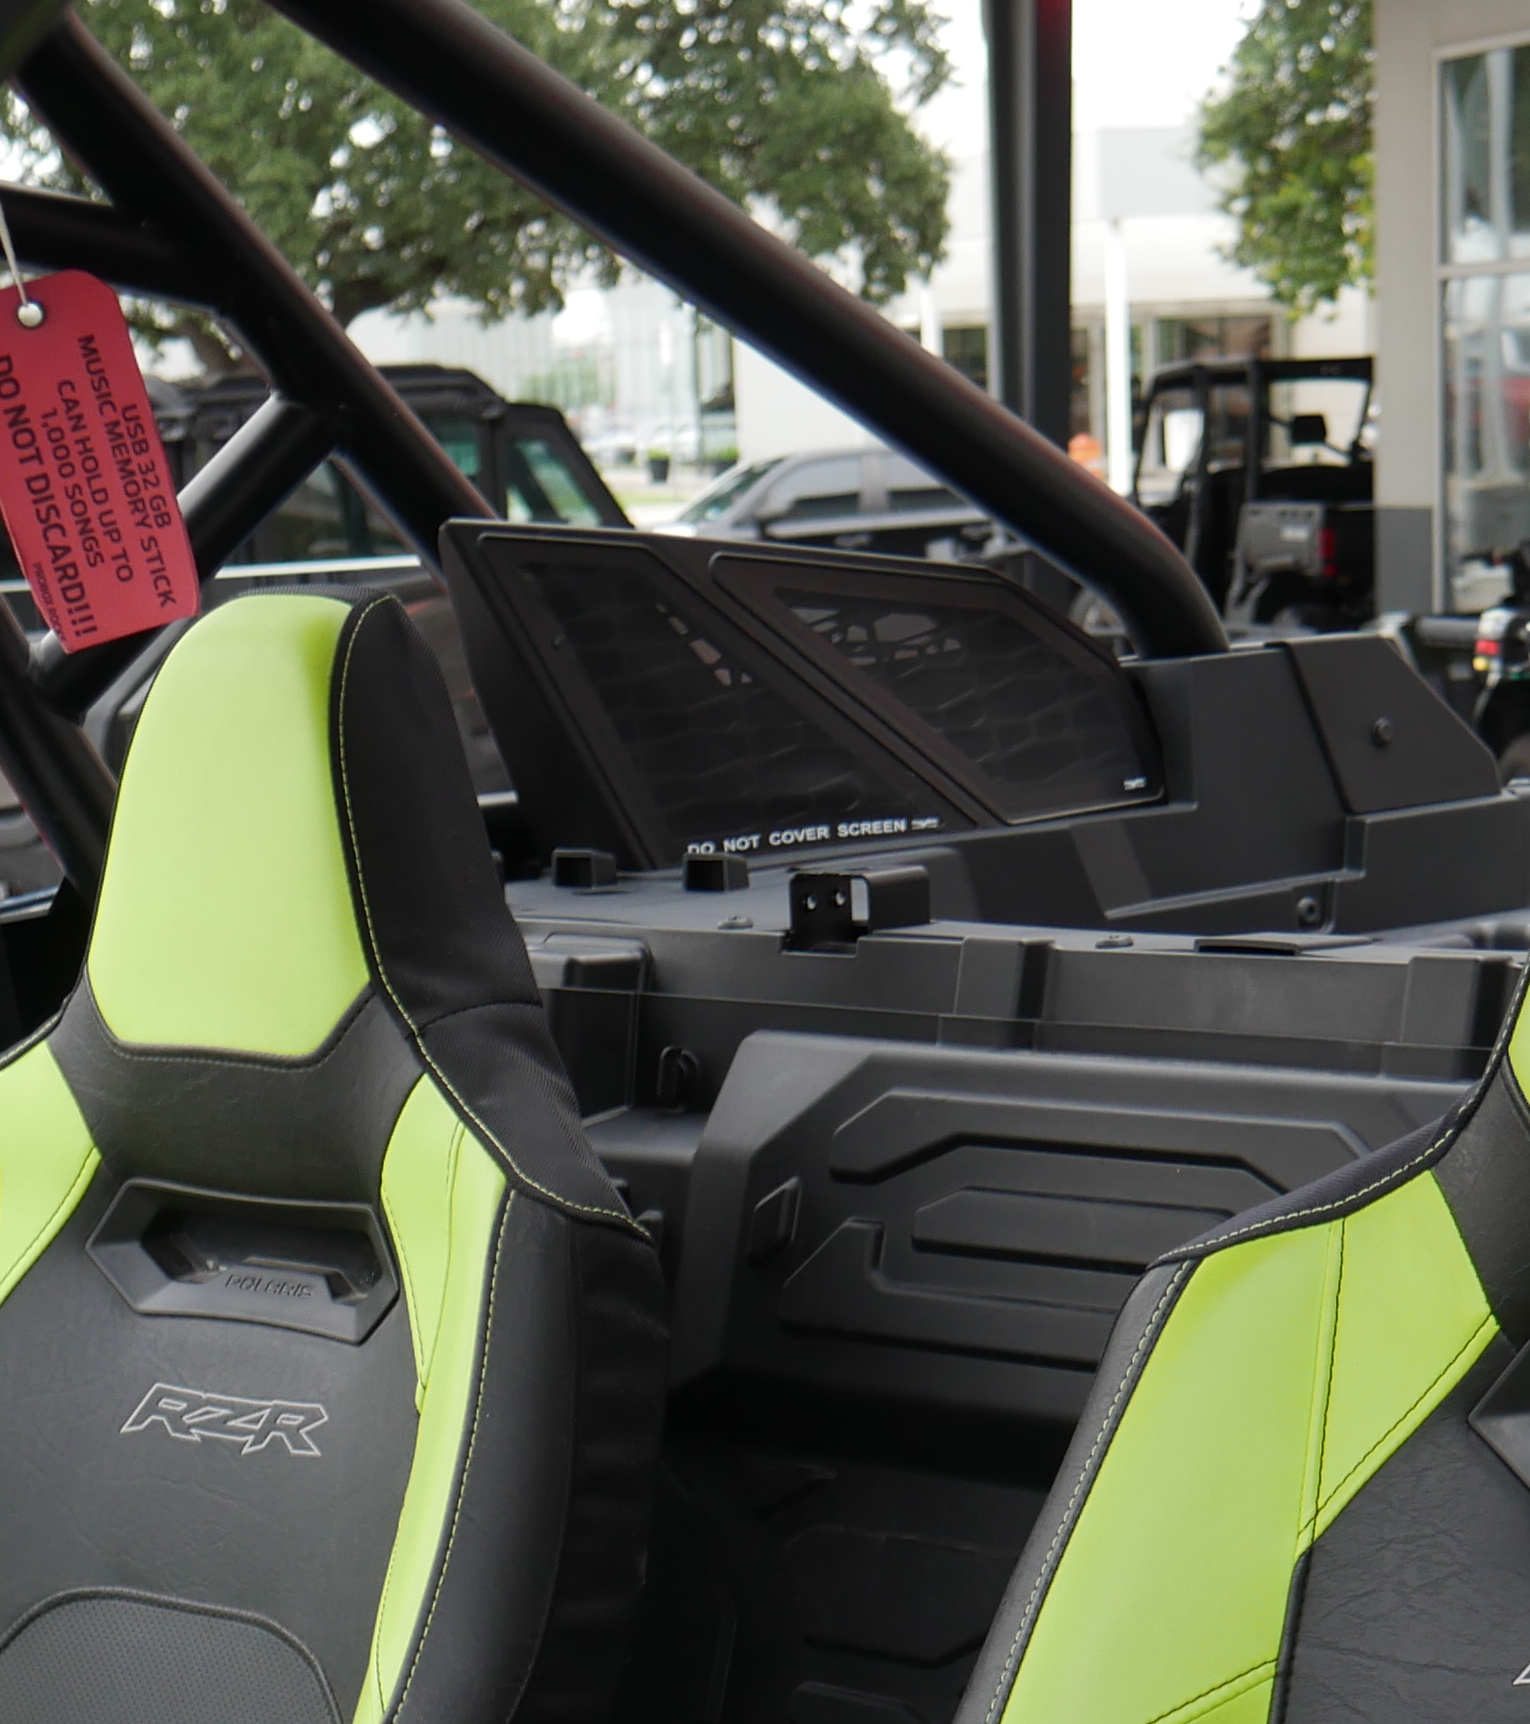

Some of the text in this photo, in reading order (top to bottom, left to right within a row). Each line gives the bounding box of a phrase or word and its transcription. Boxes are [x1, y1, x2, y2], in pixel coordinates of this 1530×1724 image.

[3, 404, 45, 465] NOT
[24, 472, 98, 637] DISCARD!!!
[40, 408, 105, 568] 1,000 SONGS
[57, 380, 134, 583] CAN HOLD UP TO
[78, 334, 177, 608] MUSIC MEMORY STICK
[121, 403, 173, 528] USB 32 GB
[687, 818, 907, 856] DO NOT COVER SCREEN
[224, 1273, 316, 1299] POLARIS
[120, 1382, 330, 1457] RZR
